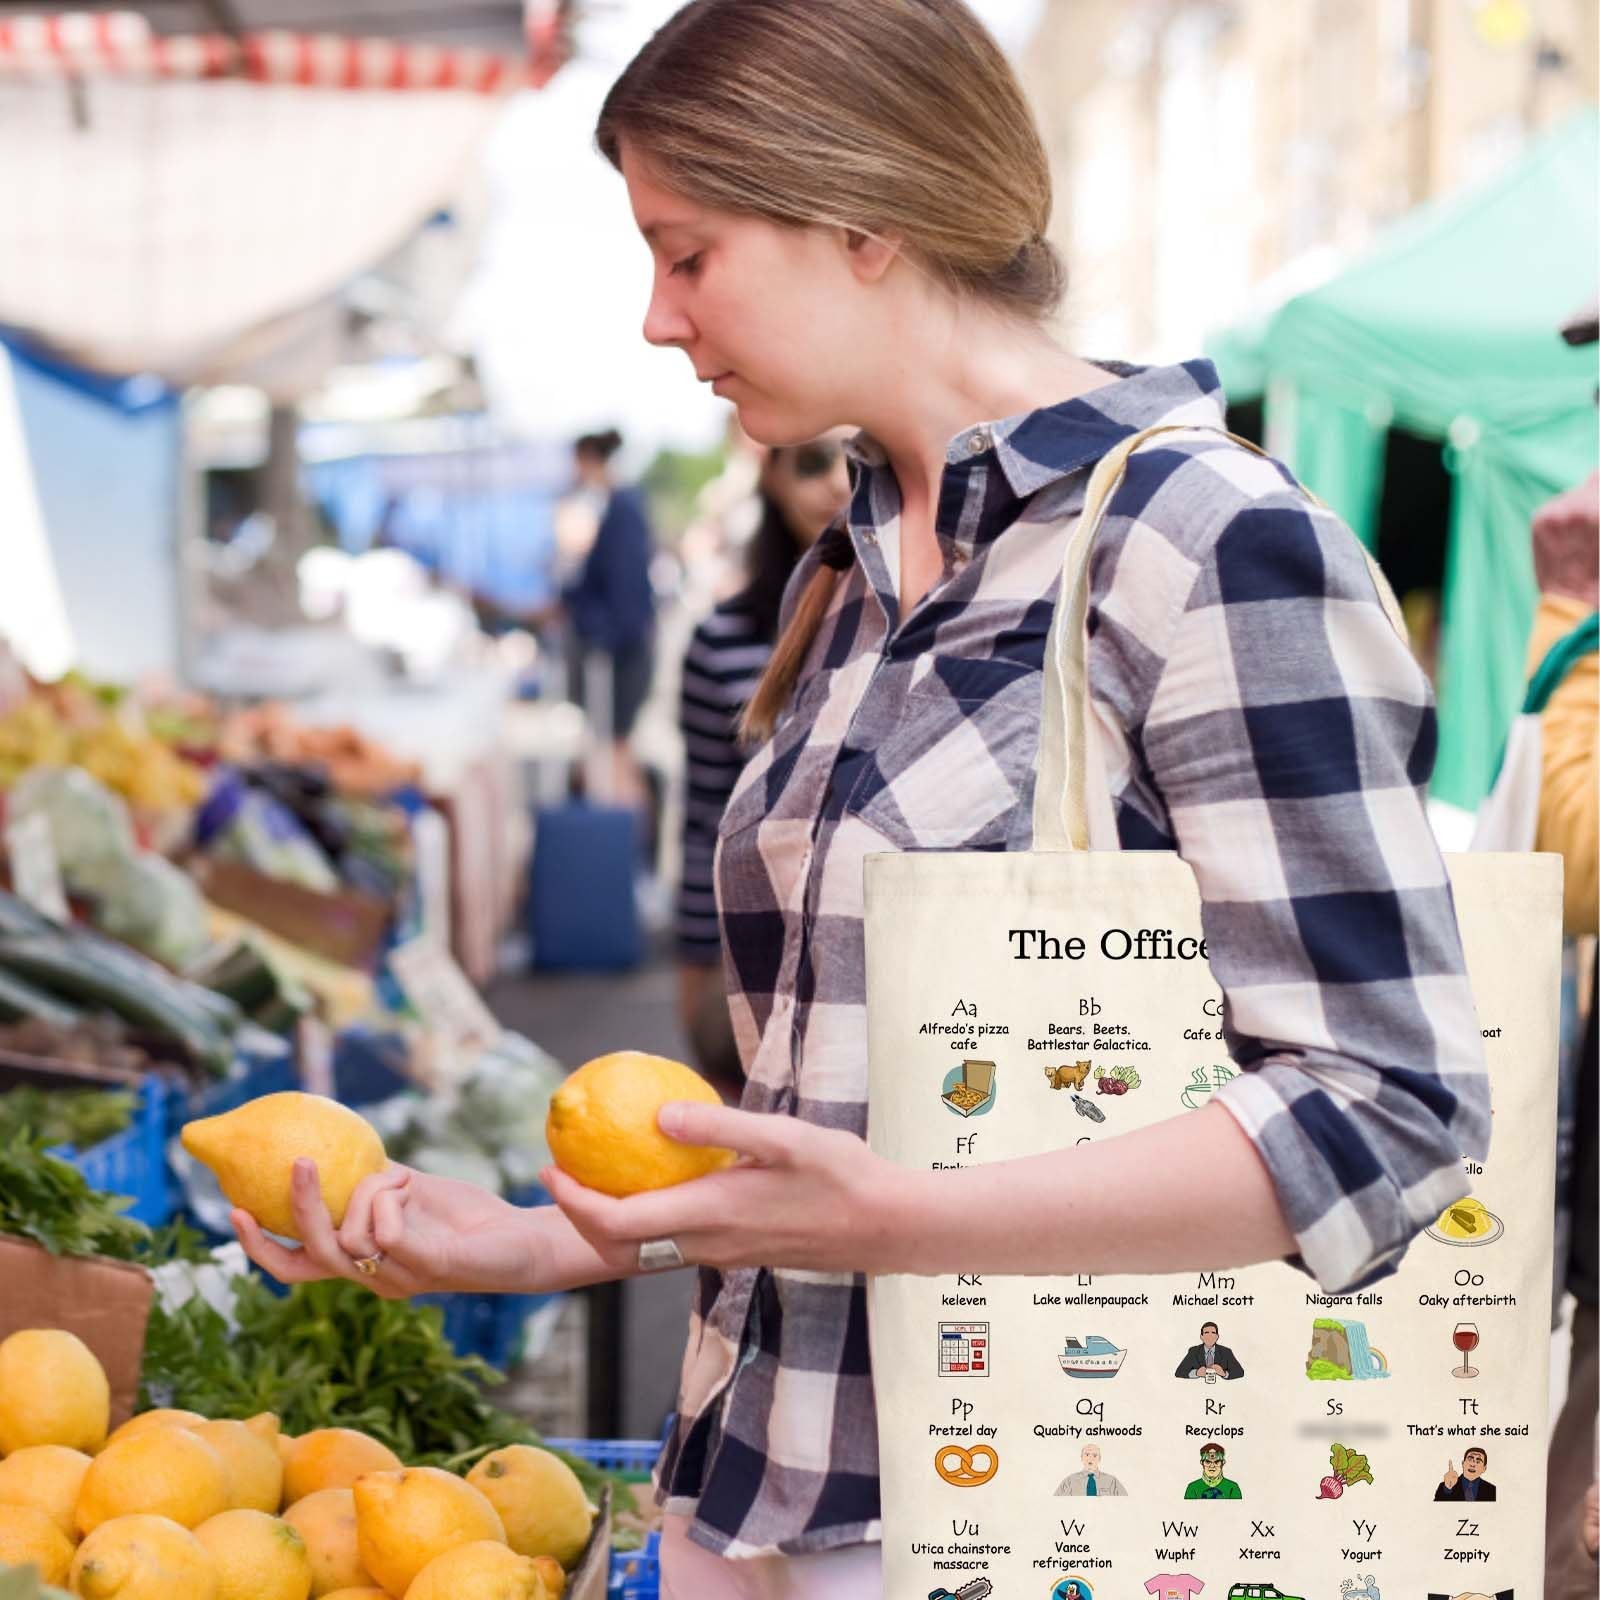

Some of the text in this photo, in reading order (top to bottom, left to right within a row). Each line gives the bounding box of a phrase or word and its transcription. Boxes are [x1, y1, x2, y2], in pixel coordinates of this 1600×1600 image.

[1008, 929, 1086, 961] The
[951, 999, 978, 1018] Aa
[1079, 996, 1102, 1017] Bb
[918, 1022, 1010, 1038] Alfredo's pizza
[1048, 1023, 1131, 1036] Bears. Beets.
[1183, 1027, 1213, 1041] Cafe
[950, 1037, 978, 1051] cafe
[1027, 1038, 1152, 1051] Battlestar Galactica.
[956, 1132, 978, 1155] Ff
[1197, 1271, 1235, 1290] Mm
[1454, 1269, 1485, 1287] Oo
[941, 1293, 987, 1306] keleven
[1033, 1293, 1149, 1309] Lake wallenpaupack
[1172, 1293, 1255, 1306] Michael scott
[1305, 1293, 1383, 1309] Niagara falls
[1418, 1293, 1517, 1309] Oaky afterbirth
[951, 1398, 974, 1422] Pp
[1075, 1398, 1104, 1423] Qq
[1205, 1398, 1226, 1416] Rr
[1326, 1398, 1344, 1416] Ss
[1458, 1398, 1479, 1416] Tt
[928, 1423, 998, 1440] Pretzel day
[1033, 1423, 1143, 1440] Quabity ashwoods
[1185, 1423, 1244, 1439] Recyclops
[1406, 1424, 1444, 1436] That's
[1447, 1424, 1477, 1437] what
[1479, 1424, 1502, 1436] she
[1504, 1424, 1529, 1437] said
[952, 1519, 979, 1537] Uu
[1060, 1519, 1086, 1537] Vv
[1162, 1520, 1199, 1538] Ww
[1250, 1520, 1275, 1538] Xx
[1352, 1519, 1377, 1543] Yy
[1455, 1518, 1480, 1537] Zz
[911, 1542, 1011, 1555] Utica chainstore
[1054, 1541, 1091, 1553] Vance
[1154, 1547, 1196, 1564] Wuphf
[1239, 1547, 1281, 1560] Xterra
[1032, 1556, 1113, 1572] refrigeration
[1340, 1548, 1383, 1564] Yogurt
[1443, 1548, 1491, 1564] Zoppity
[933, 1560, 990, 1570] massacre
